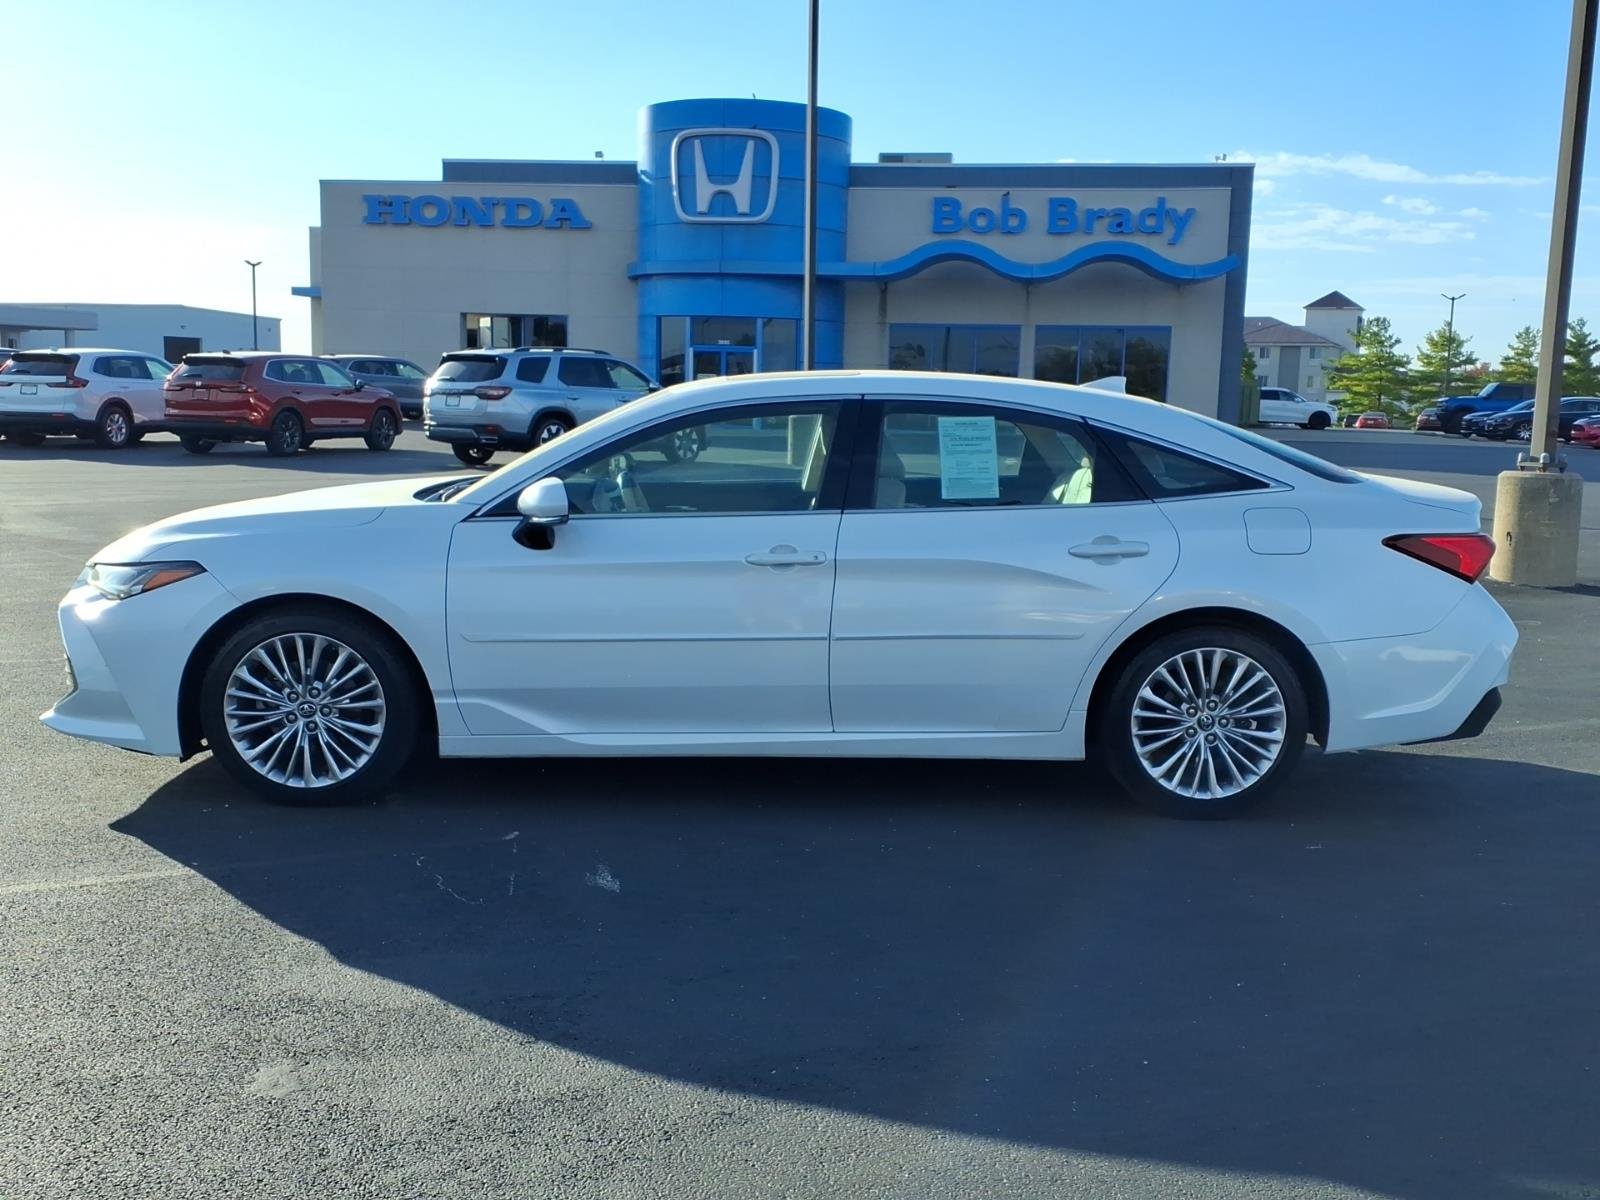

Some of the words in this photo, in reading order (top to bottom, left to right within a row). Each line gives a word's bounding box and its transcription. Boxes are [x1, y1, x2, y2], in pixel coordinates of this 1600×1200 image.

[362, 194, 593, 230] HONDA
[931, 196, 1029, 234] Bob
[1047, 196, 1197, 246] Brady
